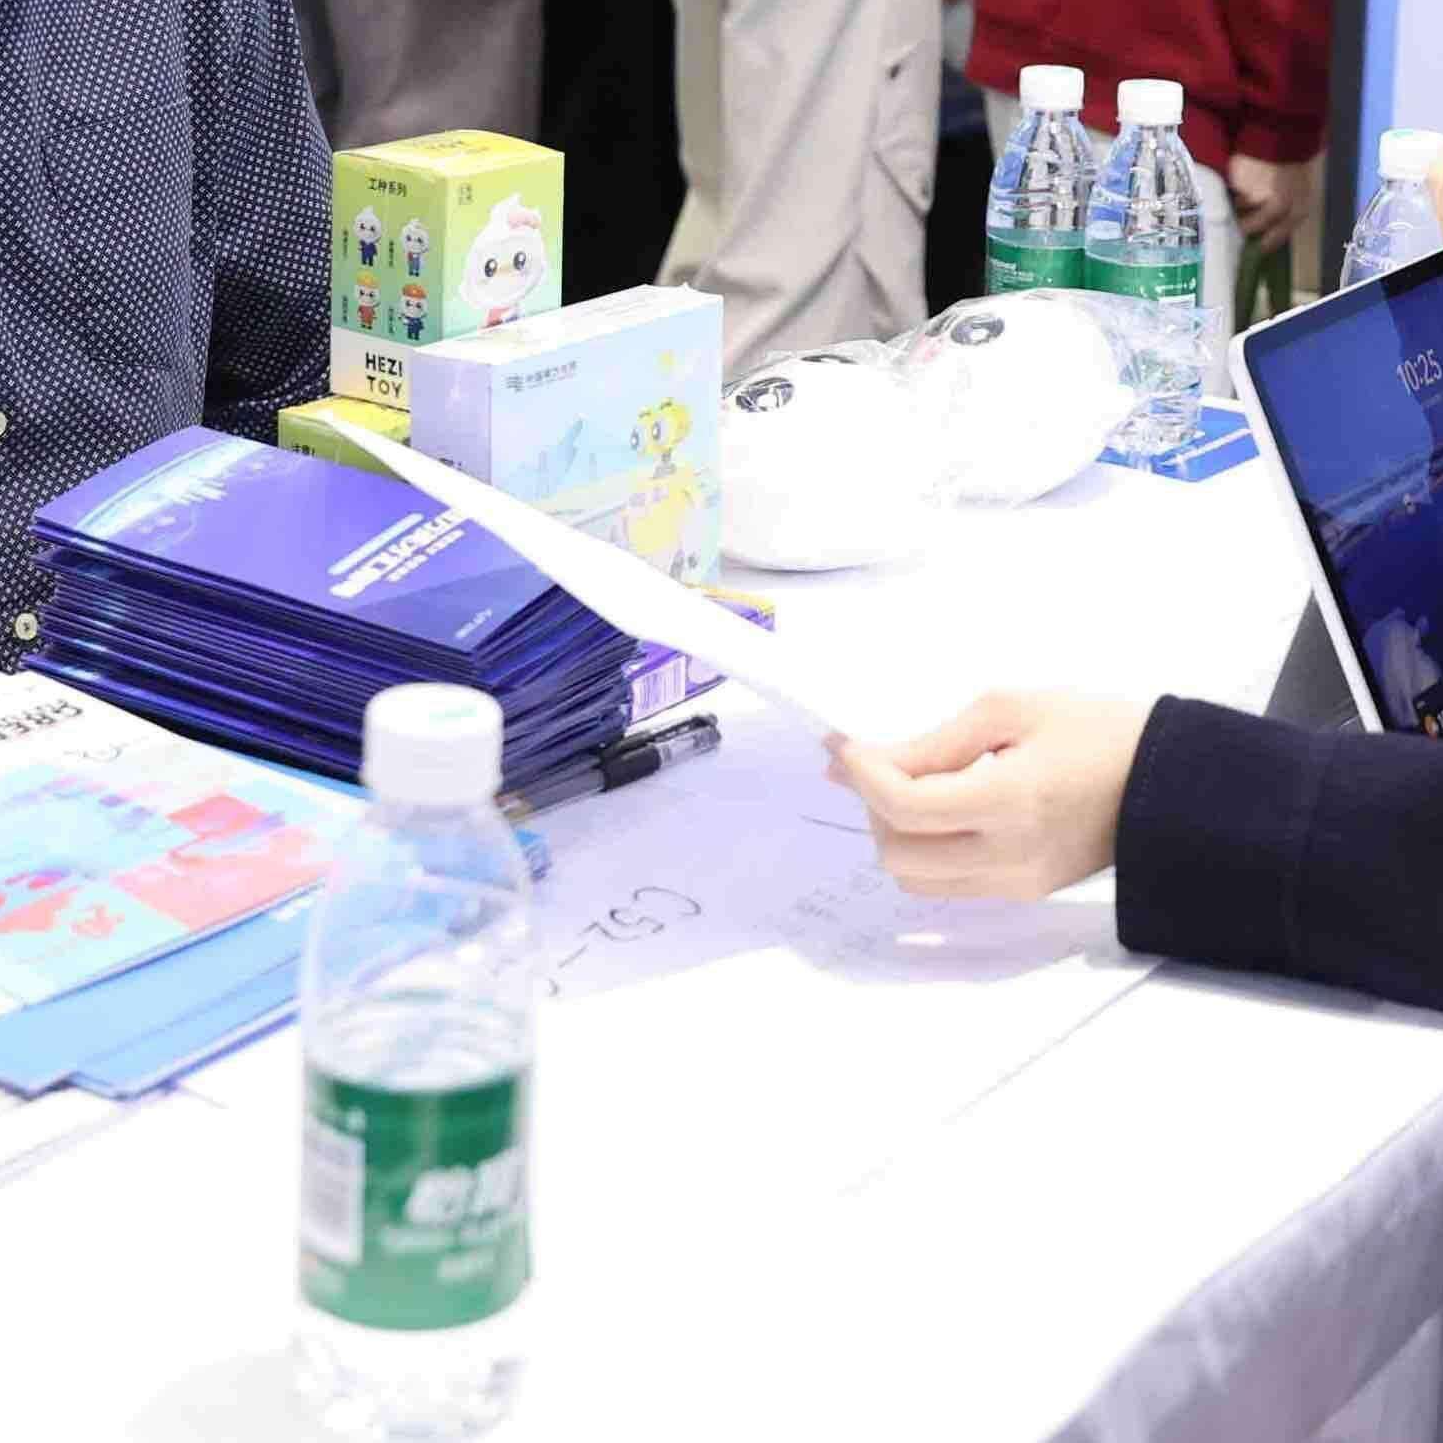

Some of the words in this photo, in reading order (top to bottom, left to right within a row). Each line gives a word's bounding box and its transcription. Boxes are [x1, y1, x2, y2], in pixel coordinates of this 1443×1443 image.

[365, 351, 404, 378] HEZI
[1395, 348, 1443, 397] 10:25
[366, 374, 403, 398] TOY
